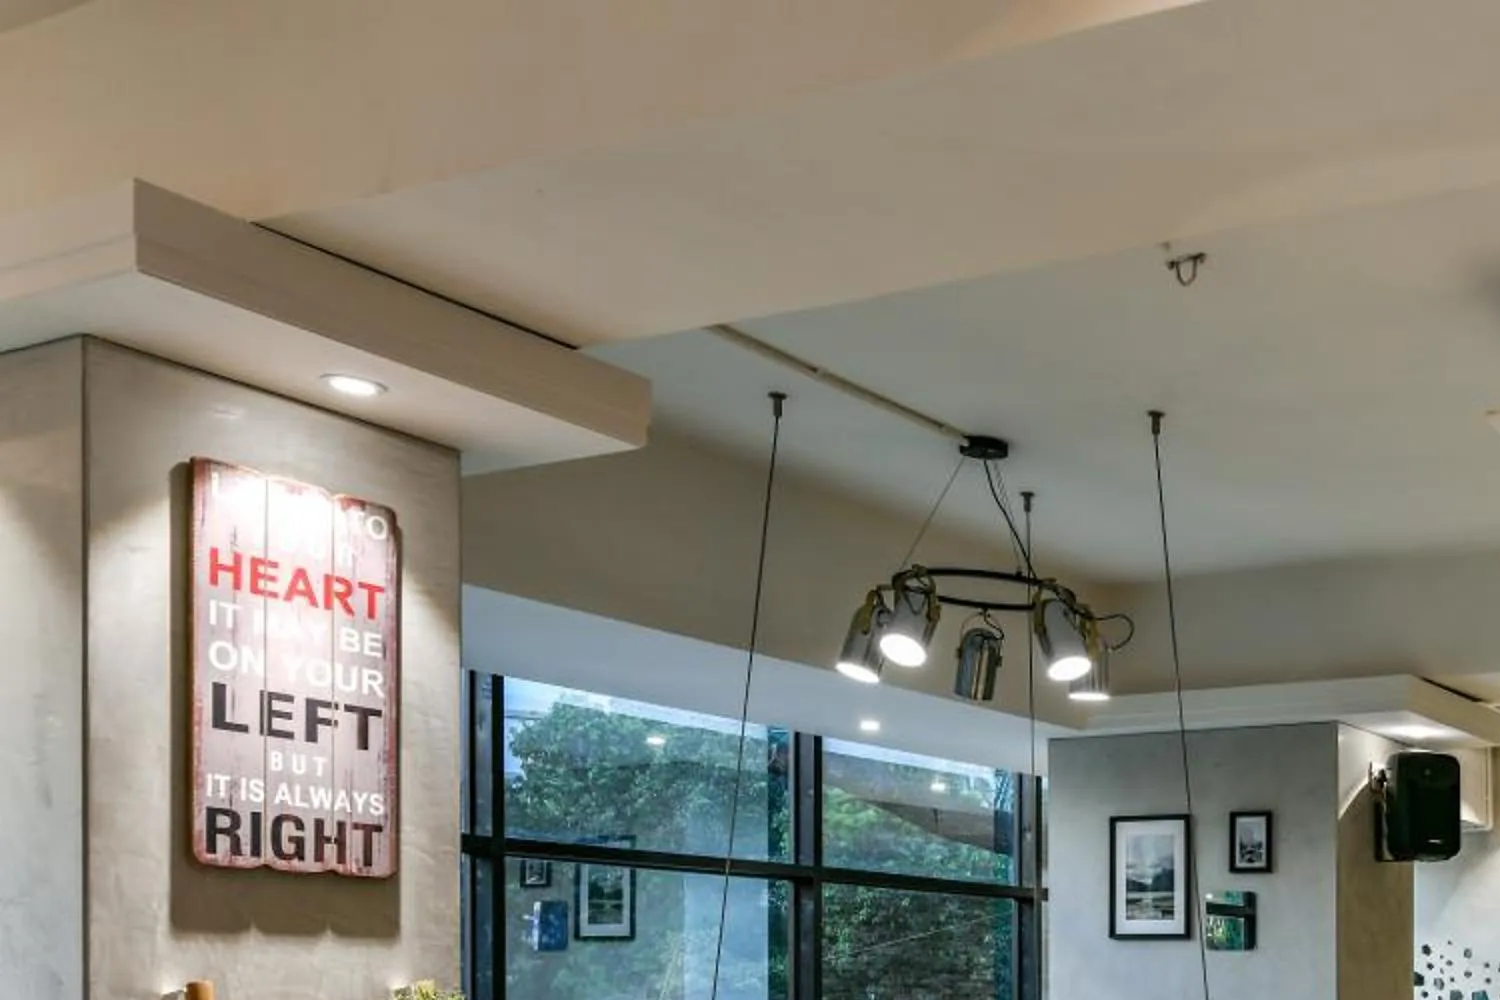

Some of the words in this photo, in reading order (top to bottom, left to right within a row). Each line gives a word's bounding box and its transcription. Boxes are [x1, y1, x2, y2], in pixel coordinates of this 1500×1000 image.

[208, 546, 386, 621] HEART
[209, 599, 241, 635] IT
[339, 626, 384, 659] BE
[208, 639, 265, 677] ON
[281, 653, 385, 698] YOUR
[211, 681, 383, 750] LEFT
[206, 773, 231, 798] IT
[240, 776, 265, 803] IS
[274, 782, 385, 816] ALWAYS
[270, 751, 328, 778] BUT
[205, 805, 383, 868] RIGHT
